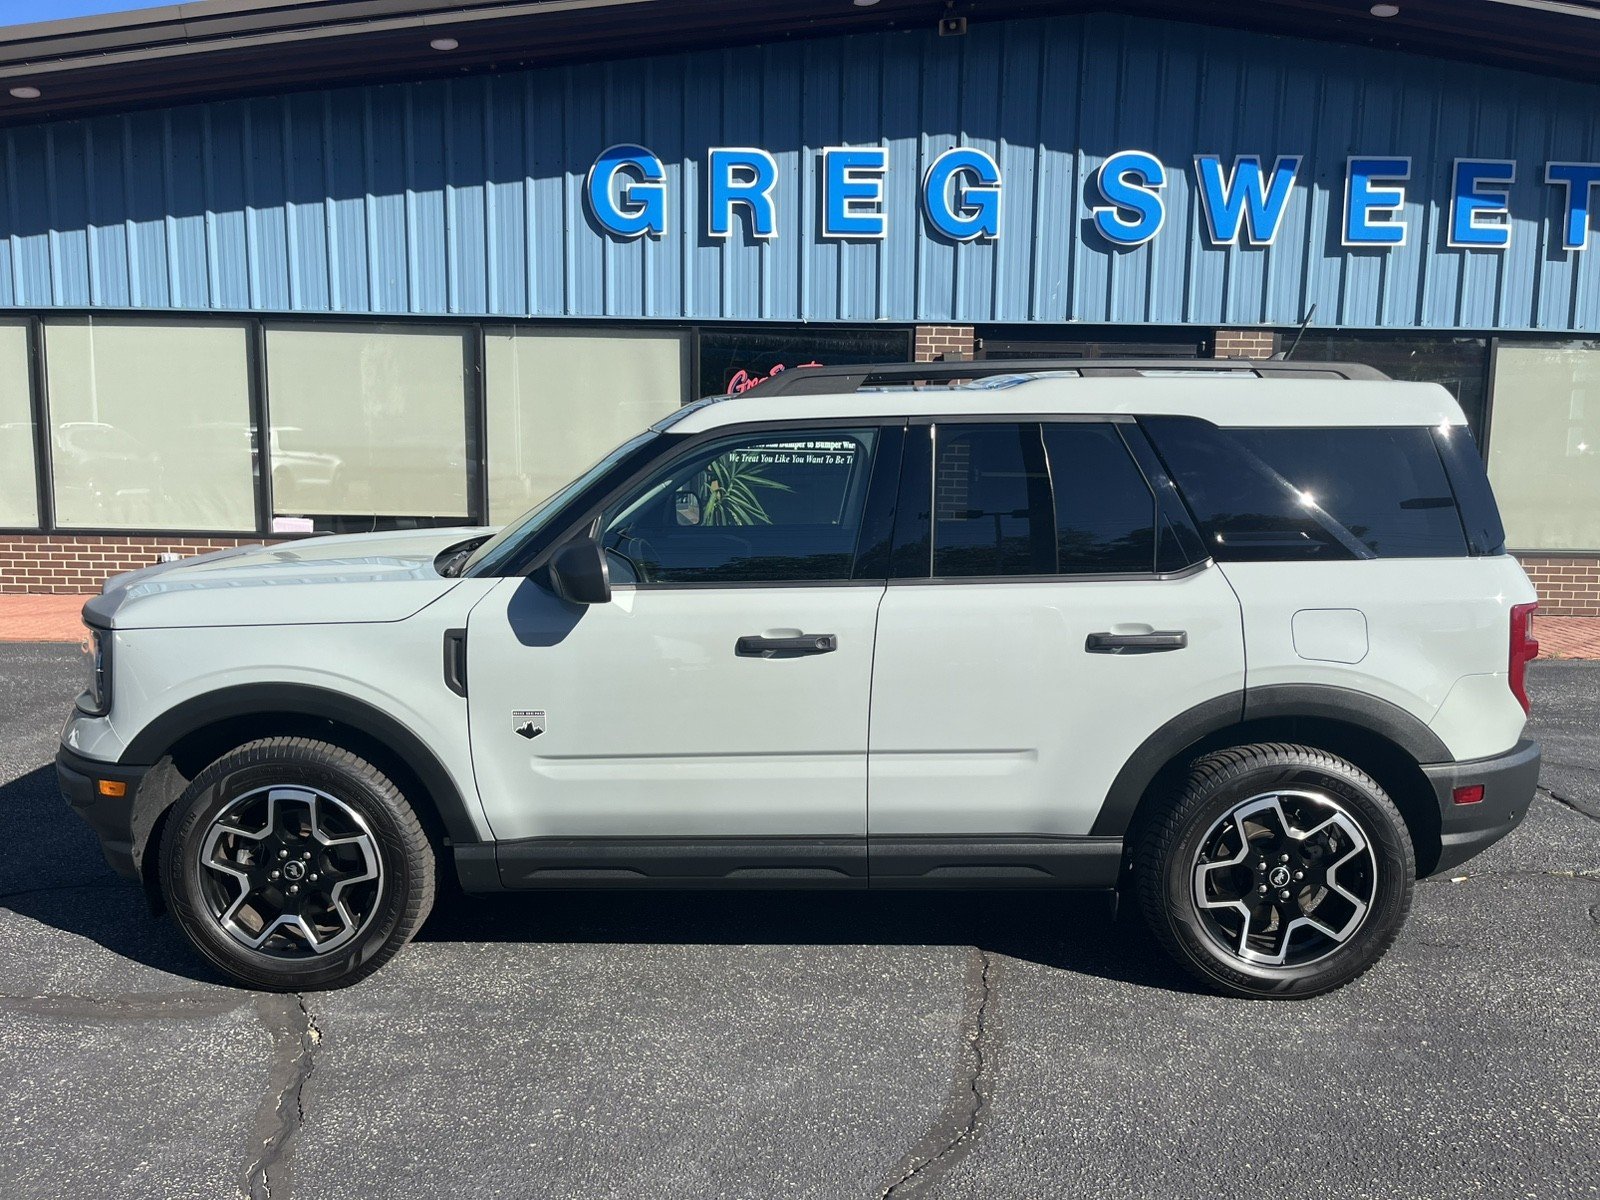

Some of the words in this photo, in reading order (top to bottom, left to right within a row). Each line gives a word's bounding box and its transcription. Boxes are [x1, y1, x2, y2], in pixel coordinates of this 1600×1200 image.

[587, 143, 1002, 240] GREG
[1093, 149, 1600, 251] SWEET
[729, 453, 739, 462] We
[741, 453, 759, 462] Treat
[761, 453, 773, 463] You
[775, 454, 790, 463] Like
[792, 454, 804, 464] You
[806, 454, 824, 464] Want
[825, 455, 834, 464] To
[835, 455, 845, 464] Be
